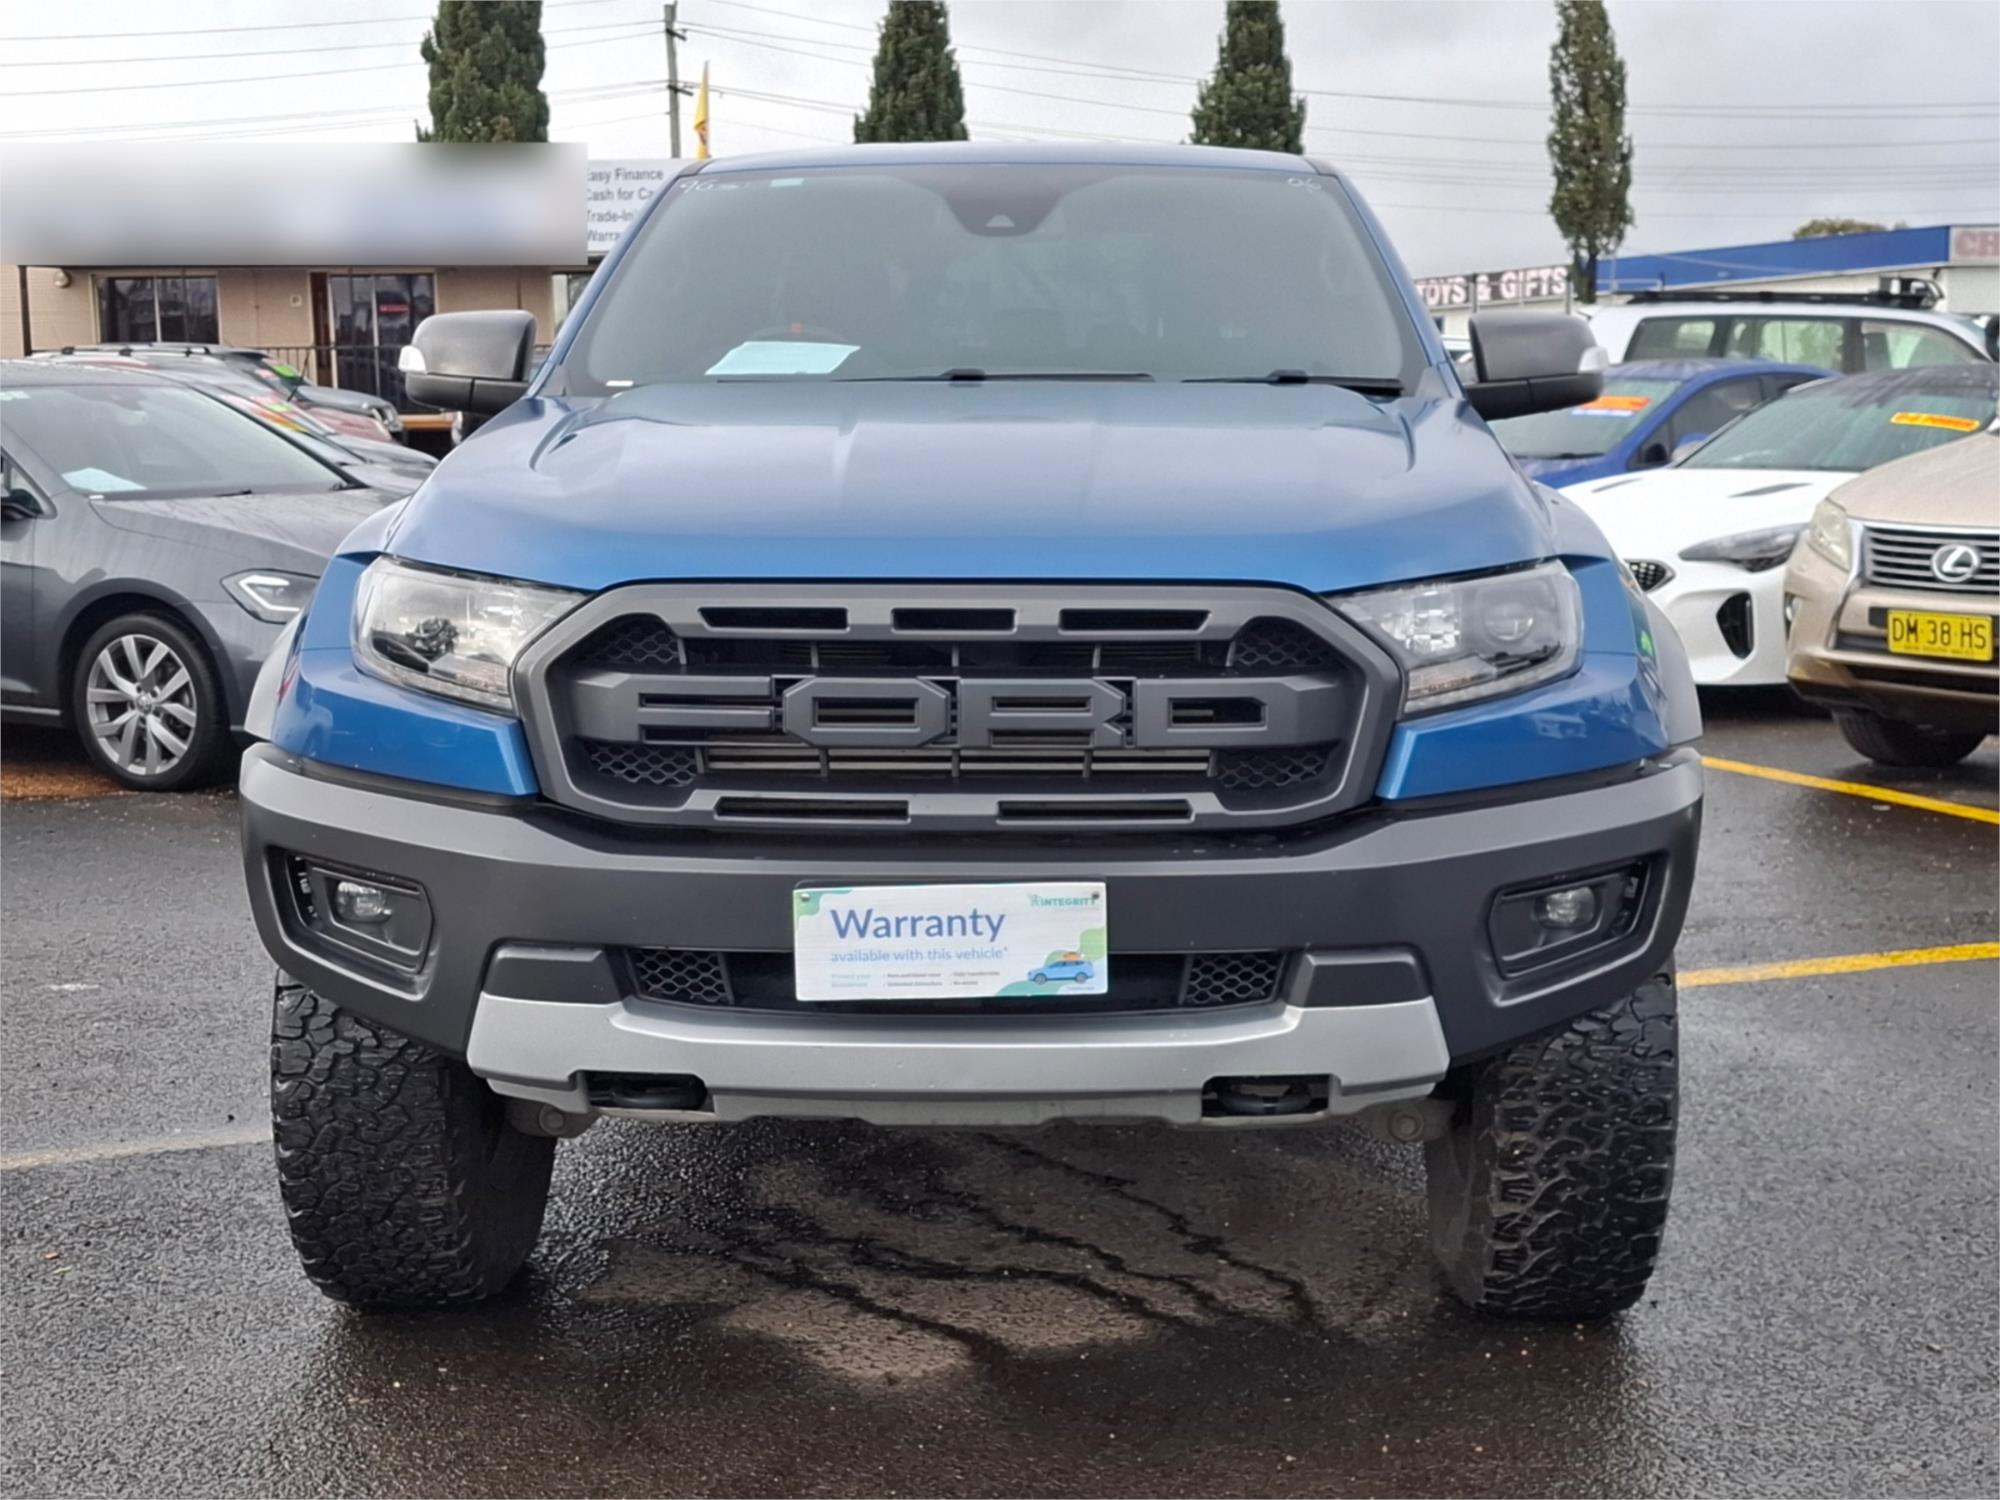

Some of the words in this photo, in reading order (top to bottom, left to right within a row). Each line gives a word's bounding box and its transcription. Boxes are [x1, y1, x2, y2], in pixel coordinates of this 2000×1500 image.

[614, 167, 663, 180] Finance
[617, 187, 634, 201] for
[1417, 277, 1466, 305] TOYS
[1476, 274, 1492, 301] &
[1501, 267, 1568, 299] GIFTS
[1927, 620, 1951, 646] 38
[597, 674, 1300, 748] FORD
[830, 908, 1006, 943] Warranty
[831, 950, 890, 962] available
[894, 949, 924, 961] with
[927, 949, 951, 960] this
